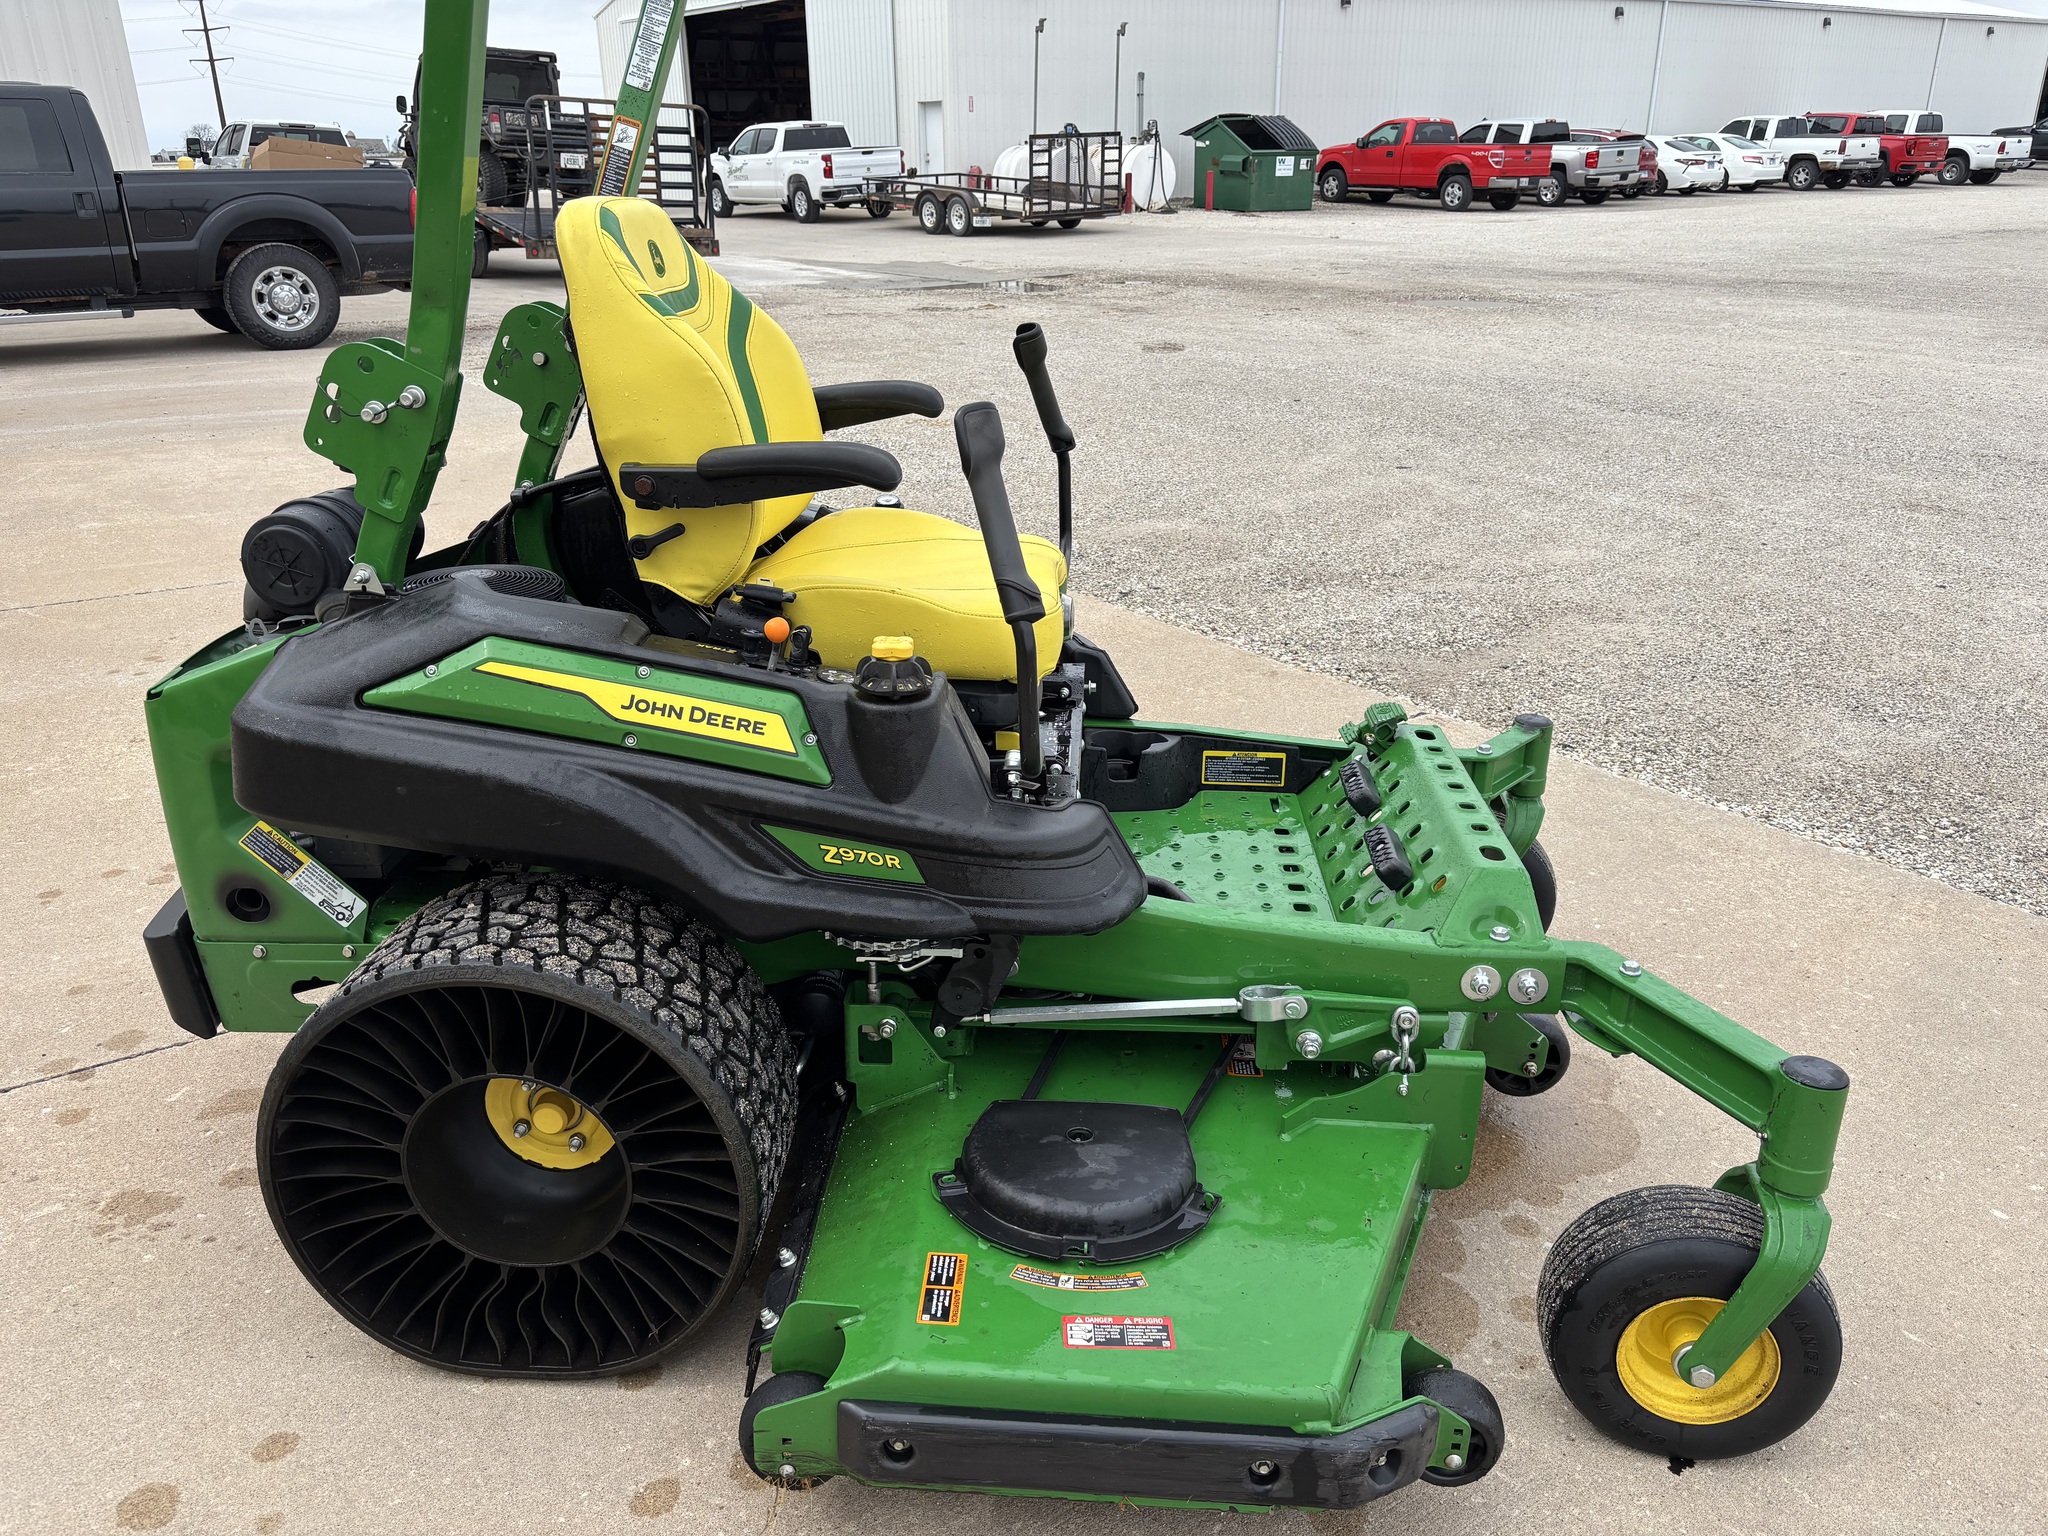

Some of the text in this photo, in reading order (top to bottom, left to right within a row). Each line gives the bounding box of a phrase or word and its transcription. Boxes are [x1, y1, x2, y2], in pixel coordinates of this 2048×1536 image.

[621, 694, 767, 736] JOHN DEERE
[272, 833, 298, 855] CAUTION
[818, 843, 904, 870] Z970R
[956, 1264, 965, 1284] WARNING
[951, 1294, 960, 1324] ADVERTENCIA
[1785, 1310, 1822, 1377] IANCE
